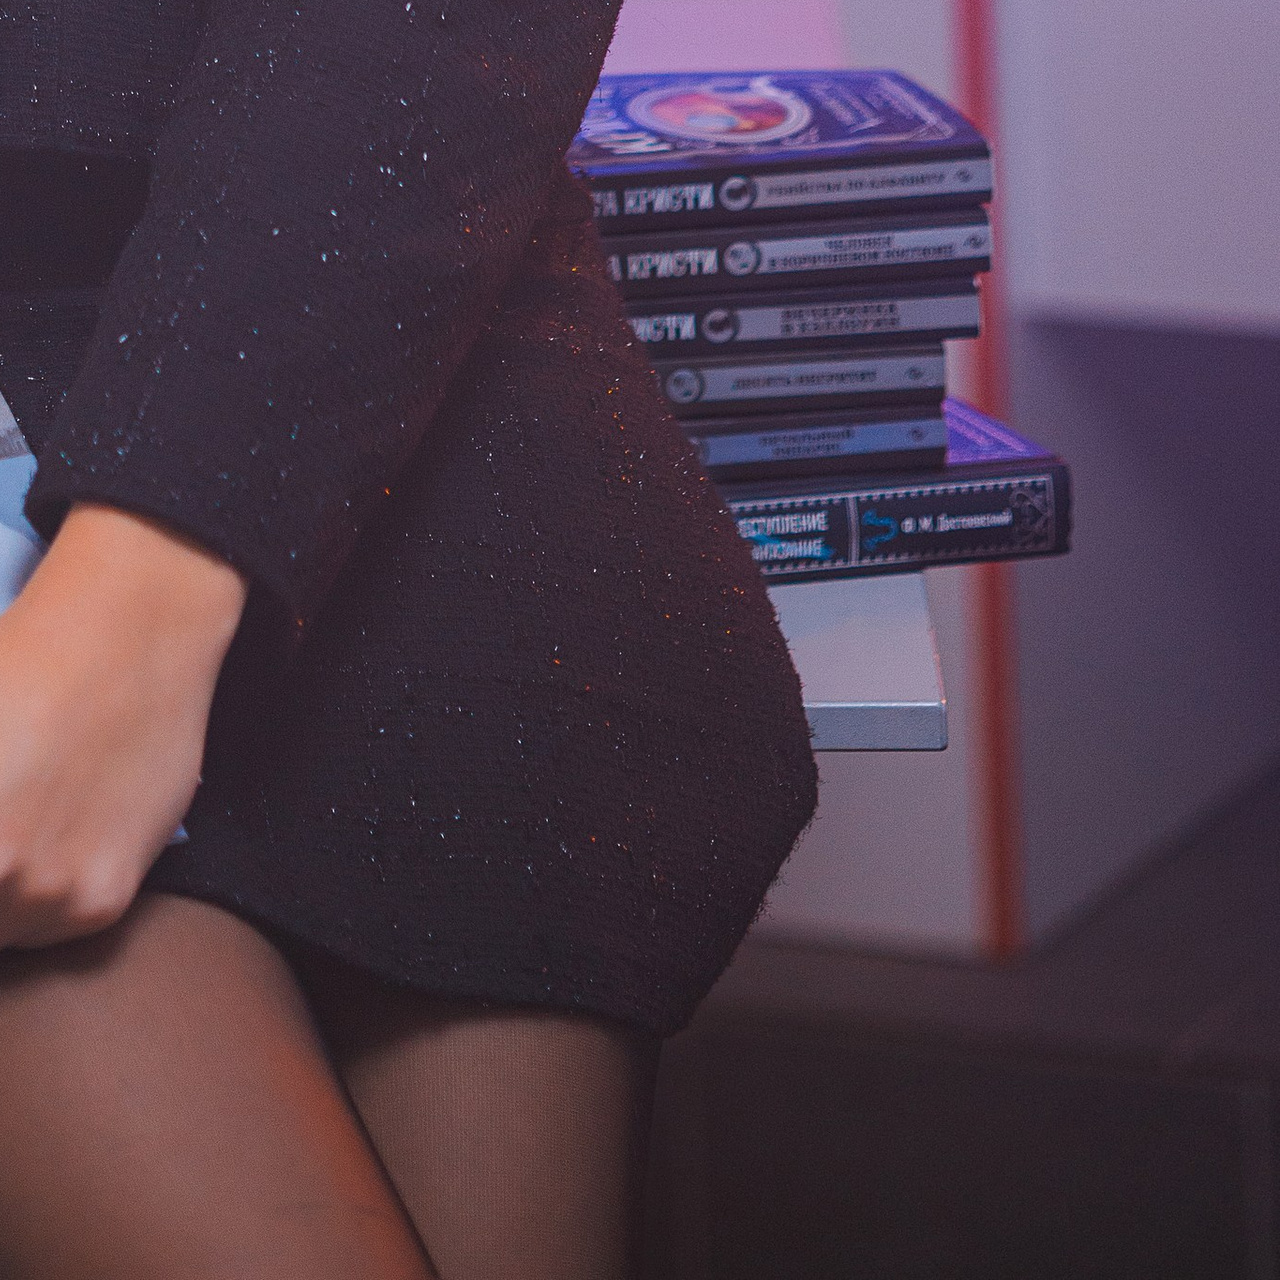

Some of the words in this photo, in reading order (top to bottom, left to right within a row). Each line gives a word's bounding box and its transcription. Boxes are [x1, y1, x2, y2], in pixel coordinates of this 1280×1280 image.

[624, 182, 715, 215] КРИСТИ
[627, 248, 718, 280] КРИСТИ
[628, 313, 696, 342] ИСТИ
[736, 510, 828, 538] ЕСТУПЛЕНИЕ
